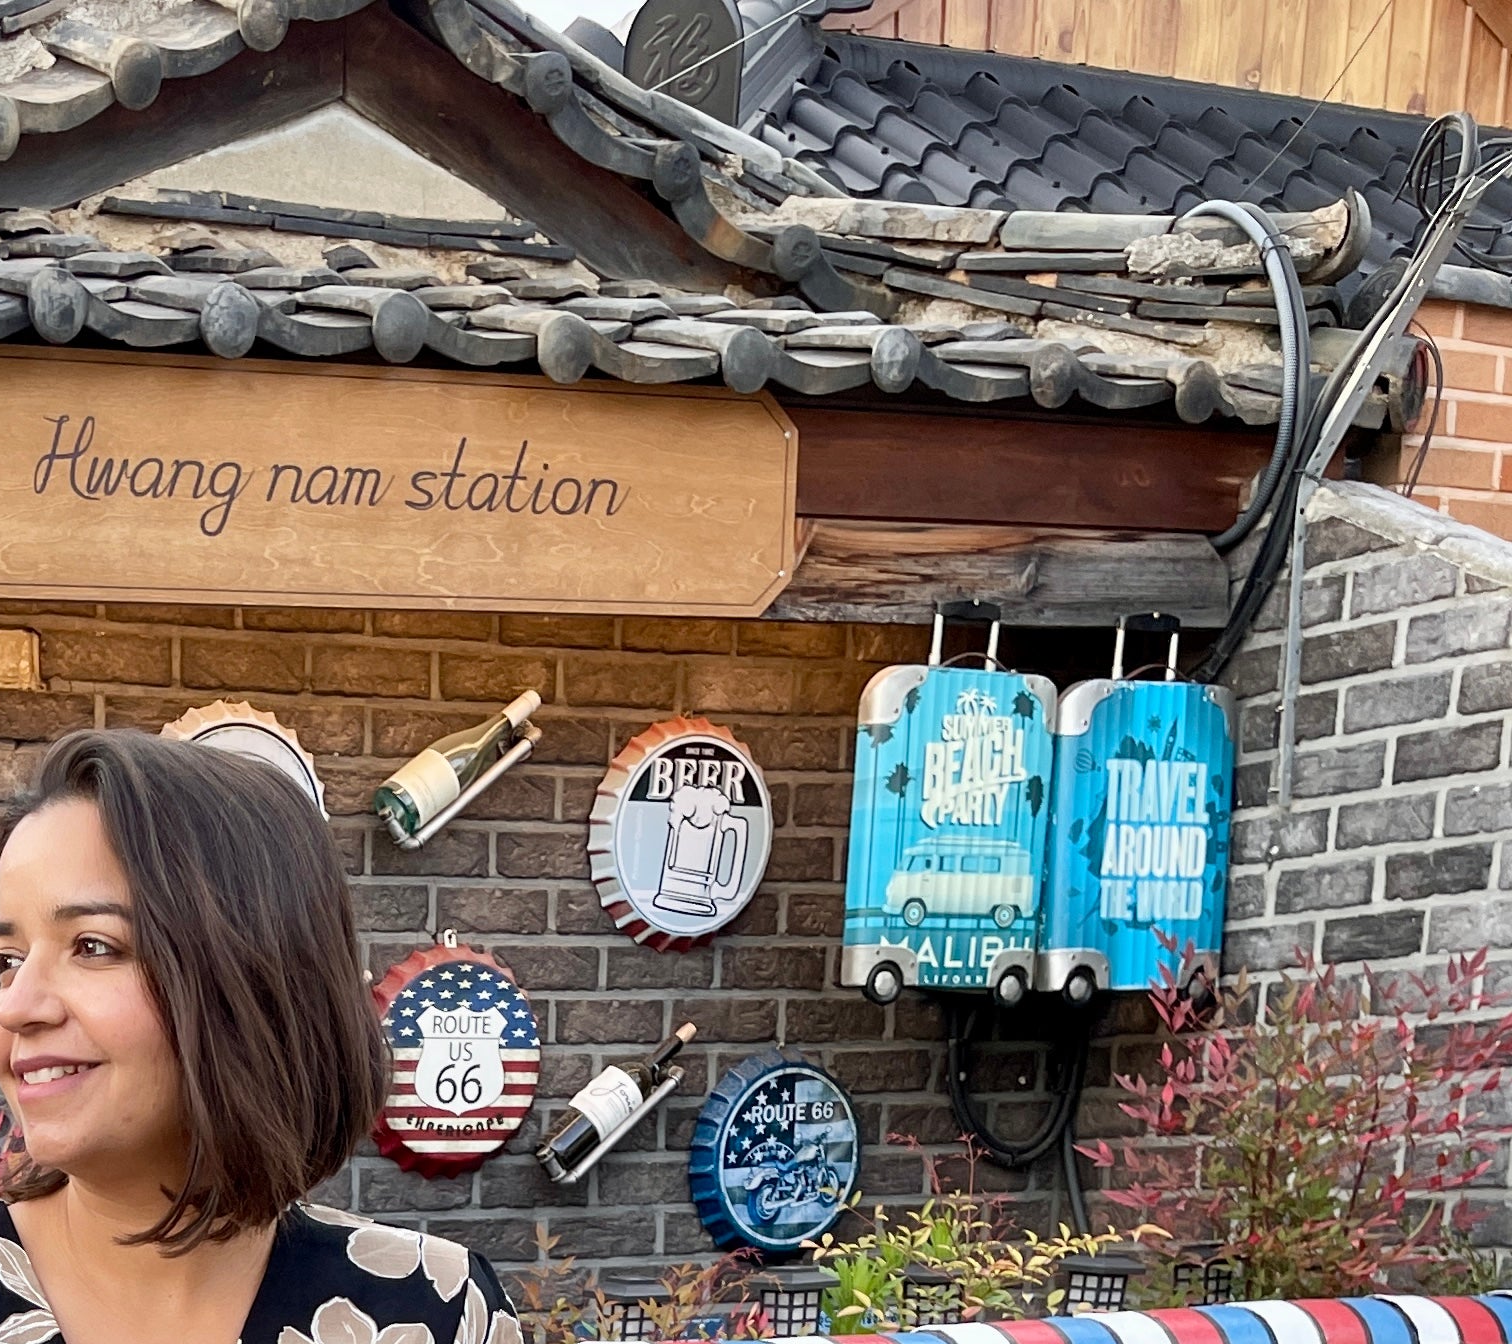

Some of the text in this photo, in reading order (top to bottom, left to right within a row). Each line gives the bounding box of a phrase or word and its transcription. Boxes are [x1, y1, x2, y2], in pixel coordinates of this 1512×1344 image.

[33, 414, 630, 537] Hwang nam station
[941, 713, 1014, 742] SUMMER
[646, 756, 746, 804] BEER
[922, 727, 1026, 801] BEACH
[937, 780, 1010, 827] PARTY
[1105, 757, 1210, 825] TRAVEL
[1099, 822, 1207, 879] AROUND
[1099, 878, 1204, 922] THE WORLD
[432, 1015, 492, 1035] ROUTE
[449, 1042, 473, 1062] US
[435, 1063, 483, 1105] 66
[750, 1101, 835, 1124] ROUTE 66
